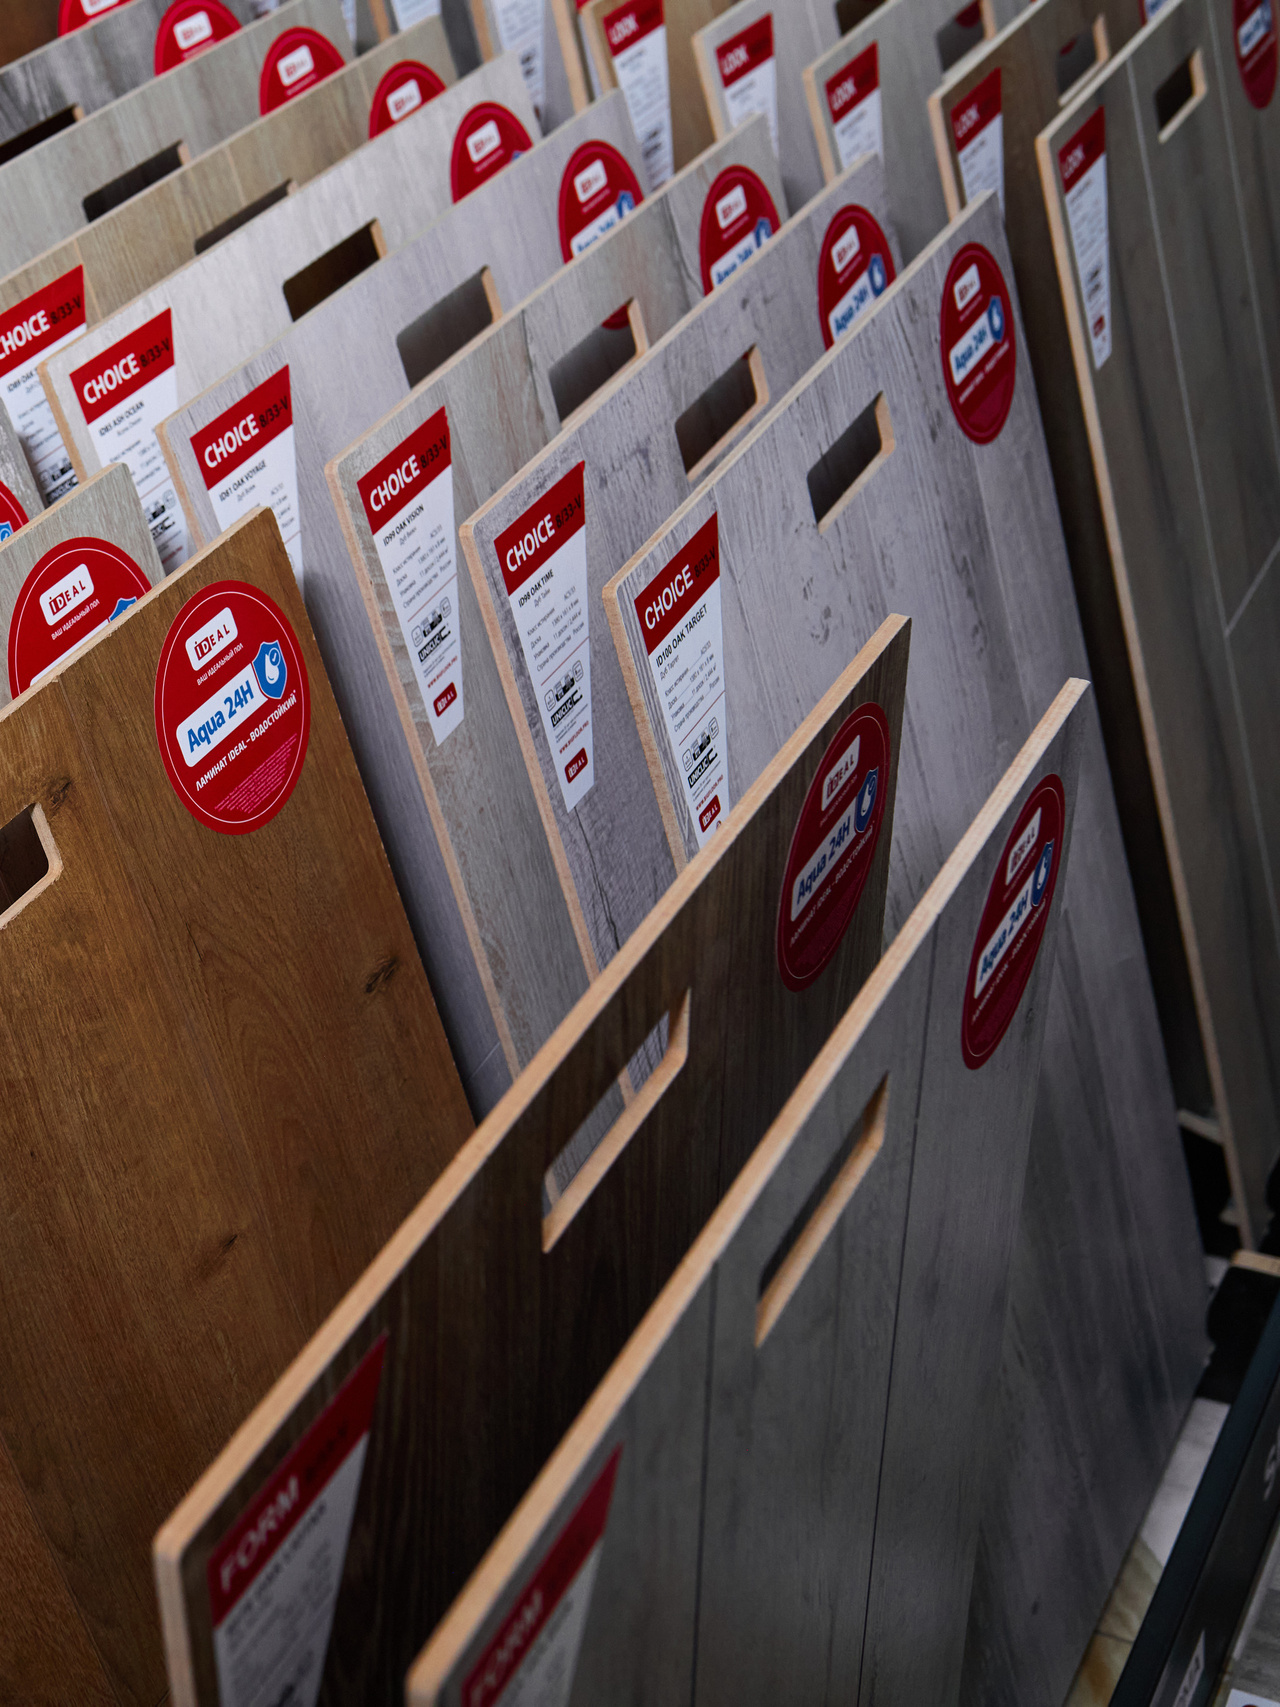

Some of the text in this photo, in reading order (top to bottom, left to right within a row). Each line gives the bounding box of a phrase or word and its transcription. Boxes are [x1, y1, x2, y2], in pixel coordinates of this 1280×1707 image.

[609, 13, 638, 45] LOOK
[51, 295, 82, 325] 8/33-V
[83, 353, 140, 404] CHOICE
[140, 338, 171, 368] 8/33-V
[954, 339, 973, 371] Aqua
[204, 414, 260, 468] CHOICE
[259, 396, 289, 428] 8/33-V
[370, 435, 448, 512] CHOICE 8/33-V
[395, 520, 408, 534] OAK
[405, 504, 424, 525] VISION
[506, 514, 555, 573] CHOICE
[555, 494, 583, 529] 8/33-V
[51, 598, 100, 641] ВАШ ИДЕАЛЬНЫЙ ПОЛ
[518, 568, 554, 608] ID98 OAK TIME
[644, 564, 694, 630] CHOICE
[694, 546, 717, 579] 8/33-V
[197, 643, 244, 686] ВАШ ИДЕАЛЬНЫЙ ПОЛ
[656, 604, 708, 667] ID100 OAK TARGET
[187, 680, 255, 753] Aqua 24H
[195, 755, 229, 792] ЛАМИНАТ
[227, 739, 248, 764] IDEAL
[689, 758, 709, 786] UNICLIC
[797, 815, 851, 905] Aqua 24H
[979, 888, 1030, 982] Aqua 24H
[221, 1475, 301, 1596] FORM
